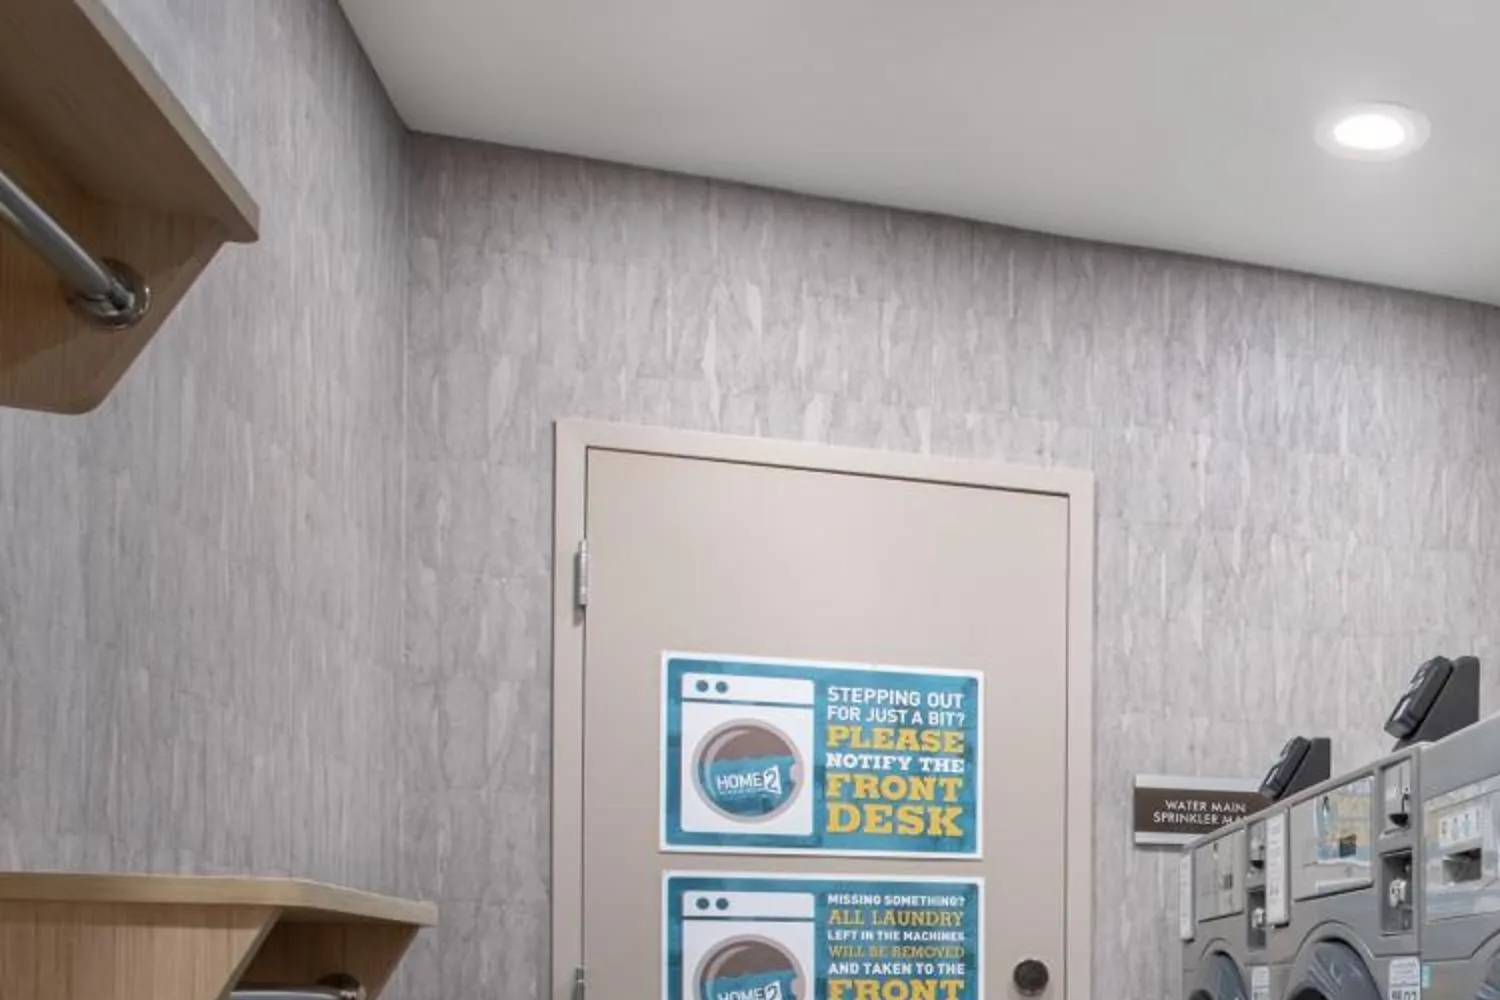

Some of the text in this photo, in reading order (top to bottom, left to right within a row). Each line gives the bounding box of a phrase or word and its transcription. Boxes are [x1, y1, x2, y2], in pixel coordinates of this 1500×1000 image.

[827, 686, 965, 708] STEPPING OUT
[827, 705, 965, 727] FOR JUST A BIT?
[826, 724, 965, 753] PLEASE
[825, 752, 965, 773] NOTIFY THE
[825, 773, 963, 802] FRONT
[1165, 800, 1247, 812] WATER MAIN
[826, 803, 964, 837] DESK
[1153, 811, 1219, 825] SPRINKLER
[827, 894, 966, 907] MISSING SOMETHING?
[828, 909, 964, 927] ALL LAUNDRY
[827, 929, 857, 941] LEFT
[861, 930, 874, 941] IN
[876, 930, 901, 941] THE
[829, 945, 865, 958] WILL
[892, 945, 965, 958] REMOVED
[828, 962, 965, 975] AND TAKEN TO THE
